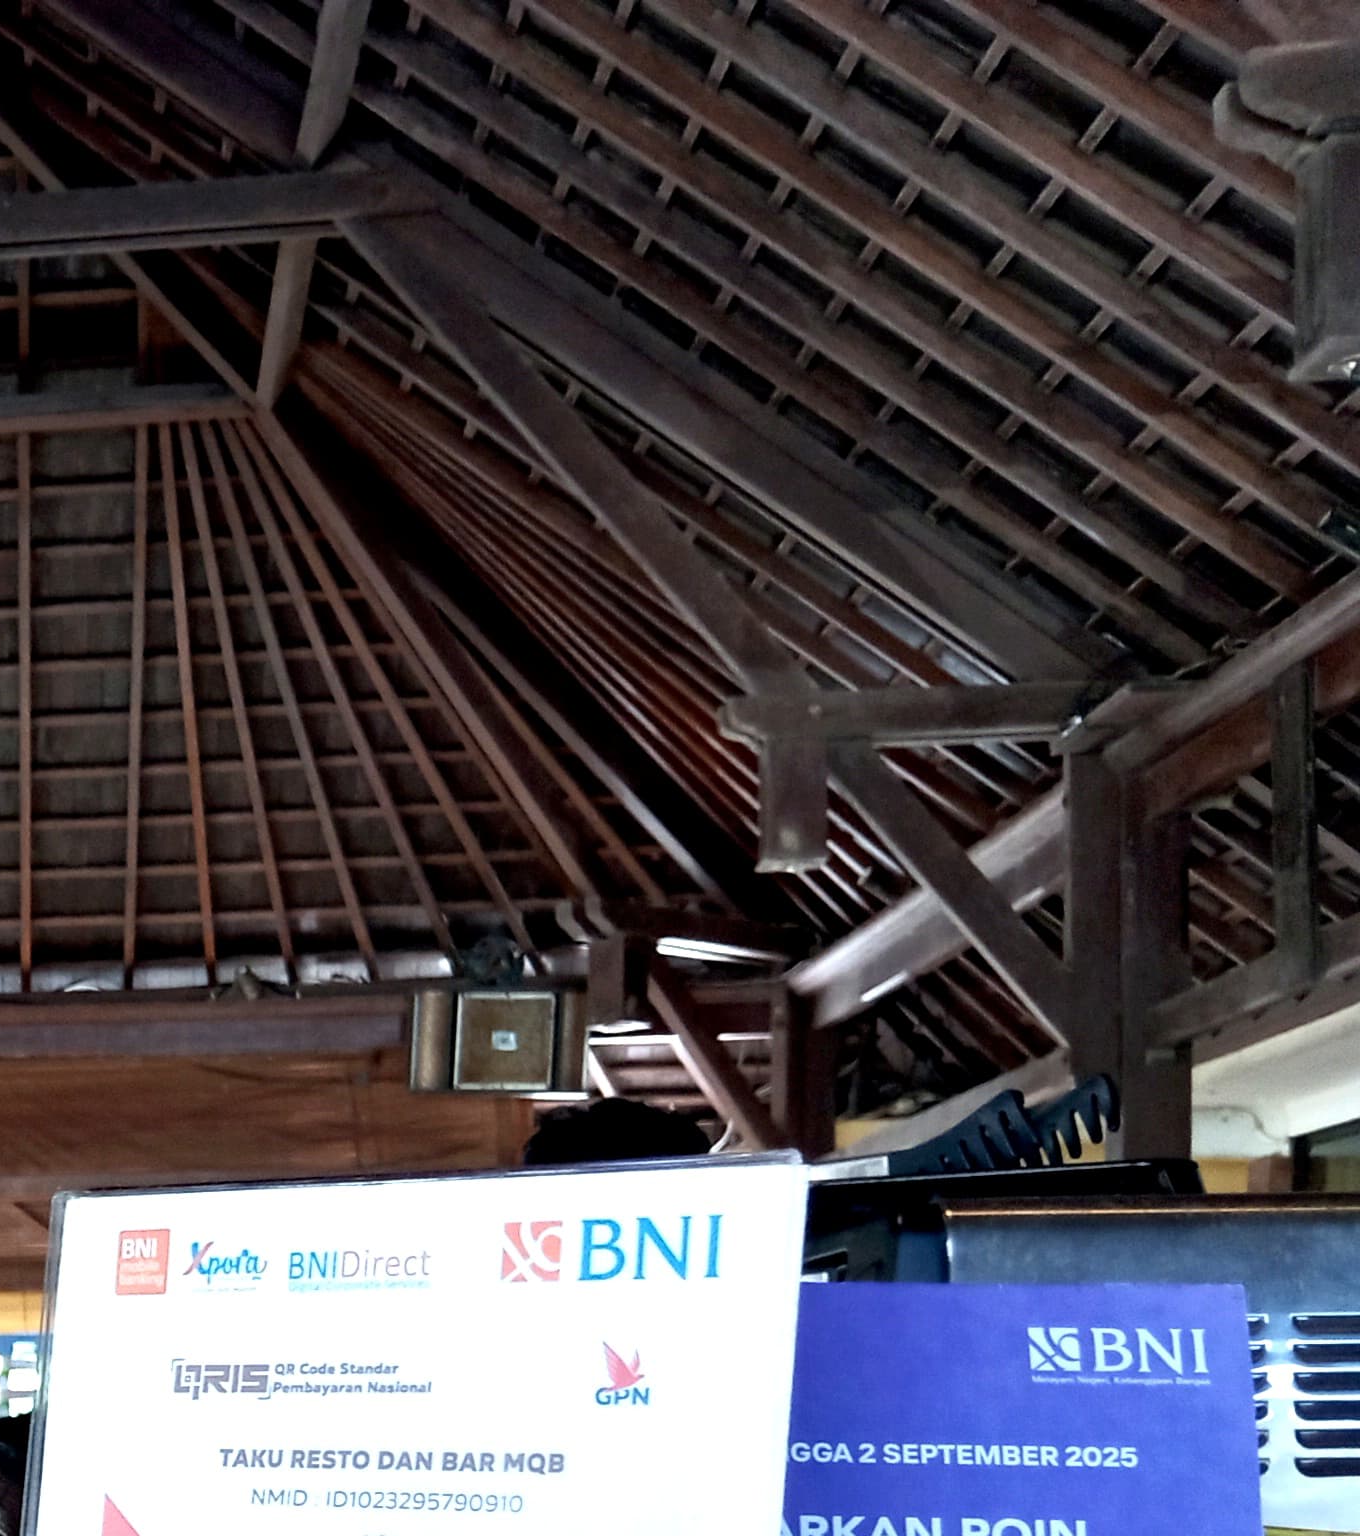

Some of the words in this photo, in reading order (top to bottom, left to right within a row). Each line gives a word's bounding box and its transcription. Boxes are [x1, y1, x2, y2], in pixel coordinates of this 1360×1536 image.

[121, 1238, 158, 1259] BNI
[577, 1215, 723, 1280] BNI
[1090, 1327, 1209, 1376] BNI
[274, 1363, 295, 1376] QR
[300, 1363, 336, 1375] Code
[340, 1363, 399, 1375] Standar
[273, 1381, 362, 1396] Pembayaran
[367, 1381, 432, 1393] Nasional
[595, 1387, 649, 1405] GPN
[219, 1448, 283, 1468] TAKU
[290, 1450, 370, 1470] RESTO
[377, 1451, 433, 1471] DAN
[441, 1452, 495, 1473] BAR
[503, 1453, 566, 1475] MQB
[788, 1442, 854, 1464] GGA
[858, 1443, 877, 1464] 2
[883, 1443, 1059, 1467] SEPTEMBER
[1065, 1445, 1138, 1468] 2025
[251, 1488, 307, 1507] NMID
[327, 1491, 523, 1513] ID1023295790910
